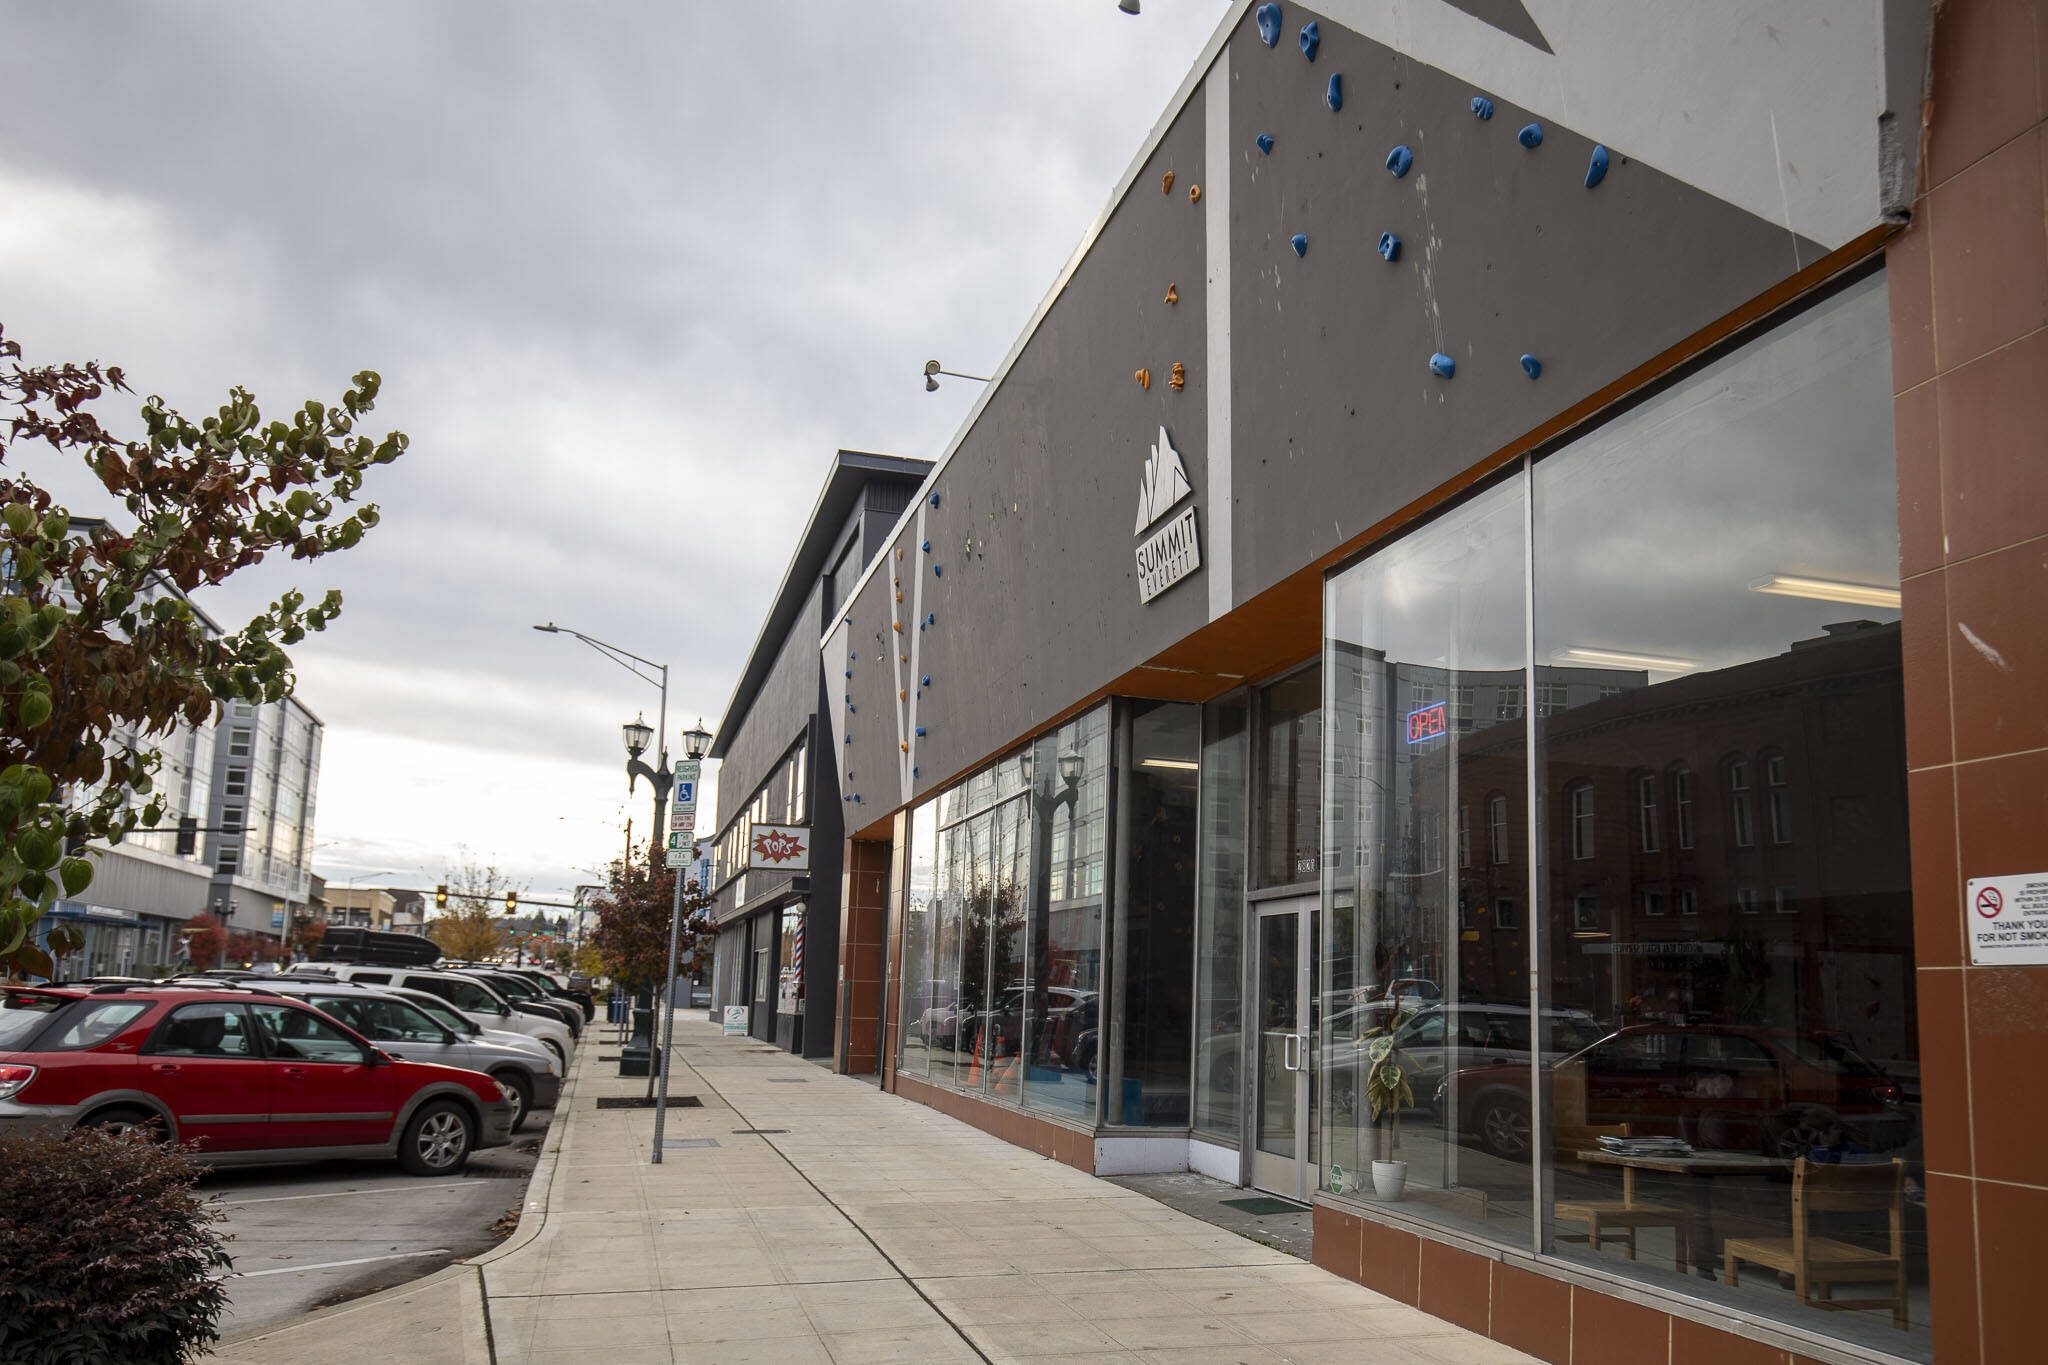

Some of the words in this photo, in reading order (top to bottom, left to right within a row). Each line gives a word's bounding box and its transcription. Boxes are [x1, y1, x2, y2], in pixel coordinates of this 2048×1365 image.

[1138, 513, 1193, 579] SUMMIT
[1146, 550, 1189, 596] EVERETT
[1409, 706, 1446, 739] OPEN
[670, 835, 677, 846] 4
[763, 838, 794, 855] POPS
[1992, 921, 2025, 930] THANK
[2028, 919, 2048, 929] YOU
[1977, 933, 1996, 942] FOR
[1998, 932, 2017, 942] NOT
[2020, 931, 2048, 940] SMOK
